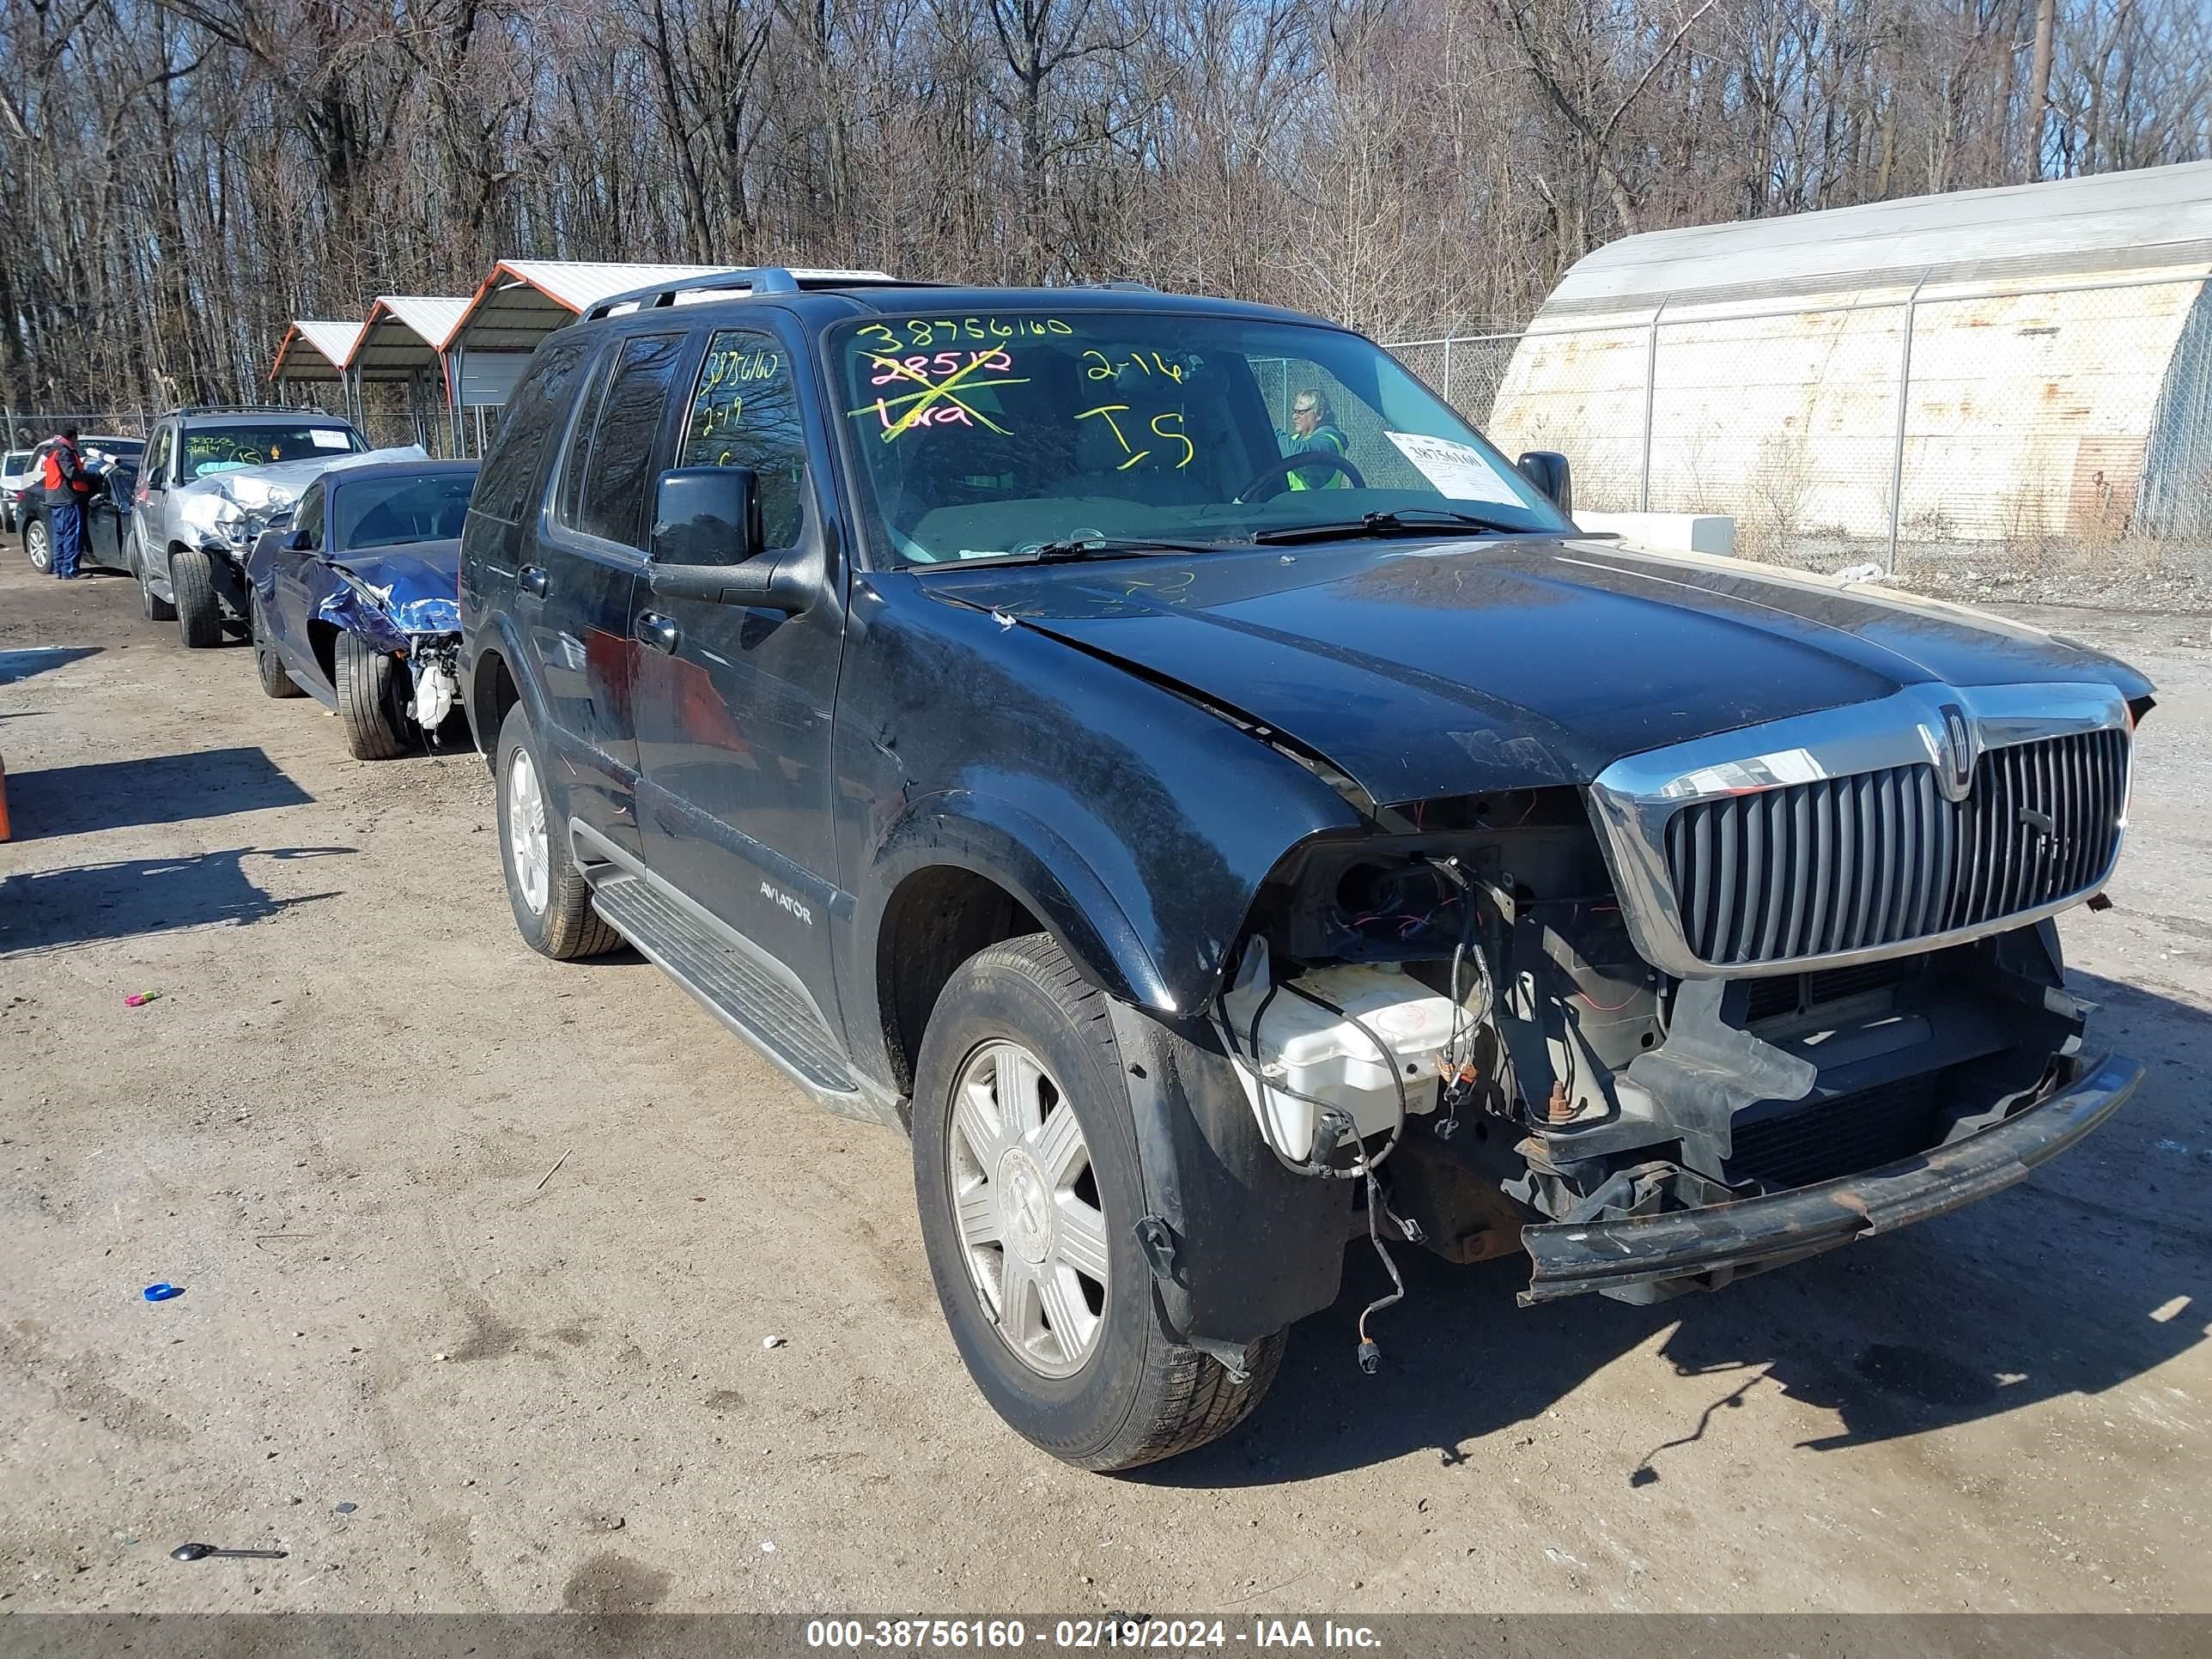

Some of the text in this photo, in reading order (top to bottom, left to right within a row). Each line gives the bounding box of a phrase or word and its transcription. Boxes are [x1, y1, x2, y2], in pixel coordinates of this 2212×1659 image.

[856, 318, 1073, 353] 38756160
[700, 349, 778, 397] 38756160
[1082, 350, 1183, 385] 2-16
[702, 397, 742, 436] 2-19
[760, 881, 812, 926] AVIATOR
